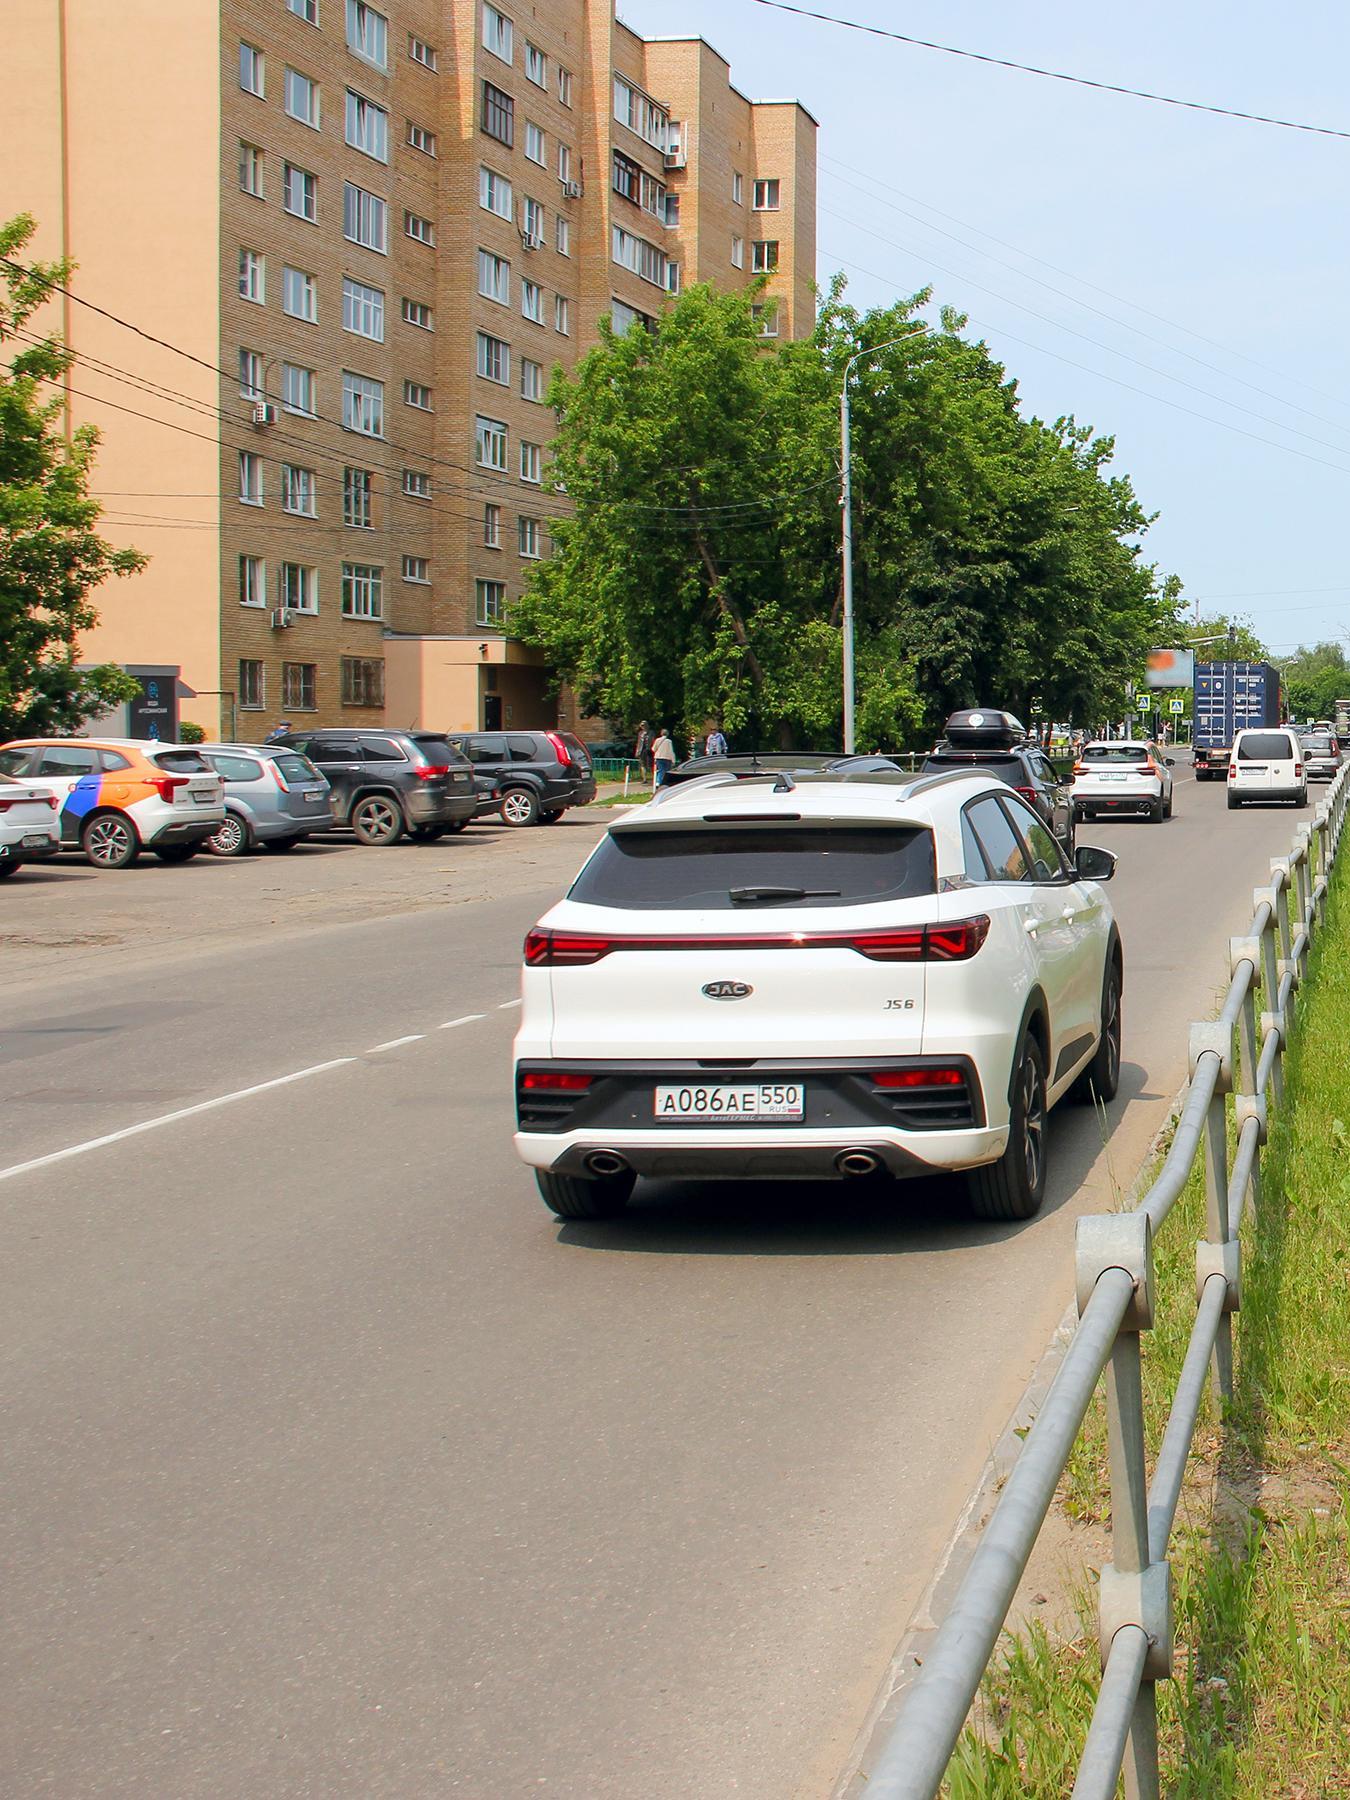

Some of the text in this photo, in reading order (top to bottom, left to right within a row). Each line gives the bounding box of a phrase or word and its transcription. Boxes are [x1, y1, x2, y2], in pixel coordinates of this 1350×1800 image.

[709, 984, 747, 995] JAC
[761, 1086, 798, 1105] 550
[769, 1105, 787, 1113] RUS
